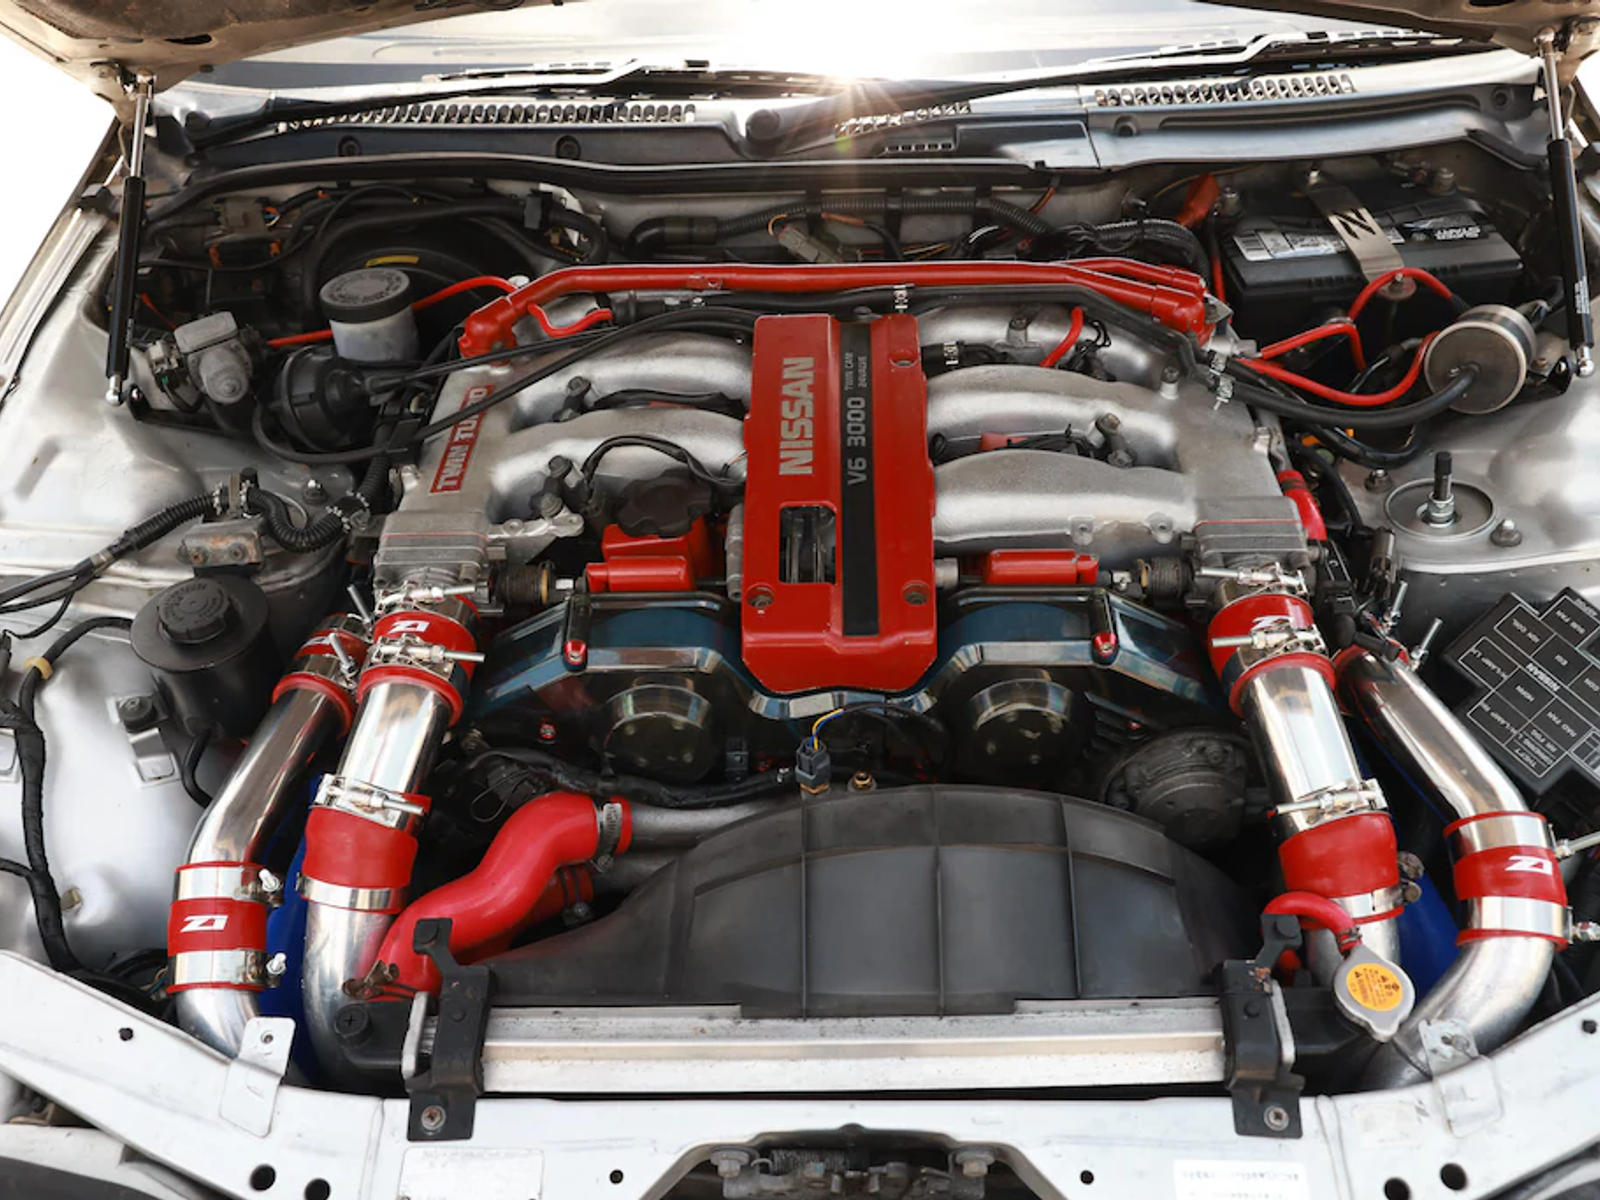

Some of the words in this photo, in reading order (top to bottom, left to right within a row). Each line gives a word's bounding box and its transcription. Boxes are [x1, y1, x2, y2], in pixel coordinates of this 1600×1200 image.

[844, 352, 854, 369] CAM
[844, 371, 854, 391] TWIN
[779, 357, 814, 475] NISSAN
[846, 396, 867, 446] 3000
[436, 444, 470, 490] TWIN
[453, 387, 488, 443] TUO
[846, 457, 867, 485] V6
[1525, 661, 1561, 693] NISSAN
[1515, 684, 1535, 702] HORN
[1546, 710, 1562, 726] FAN
[180, 915, 228, 933] Z1
